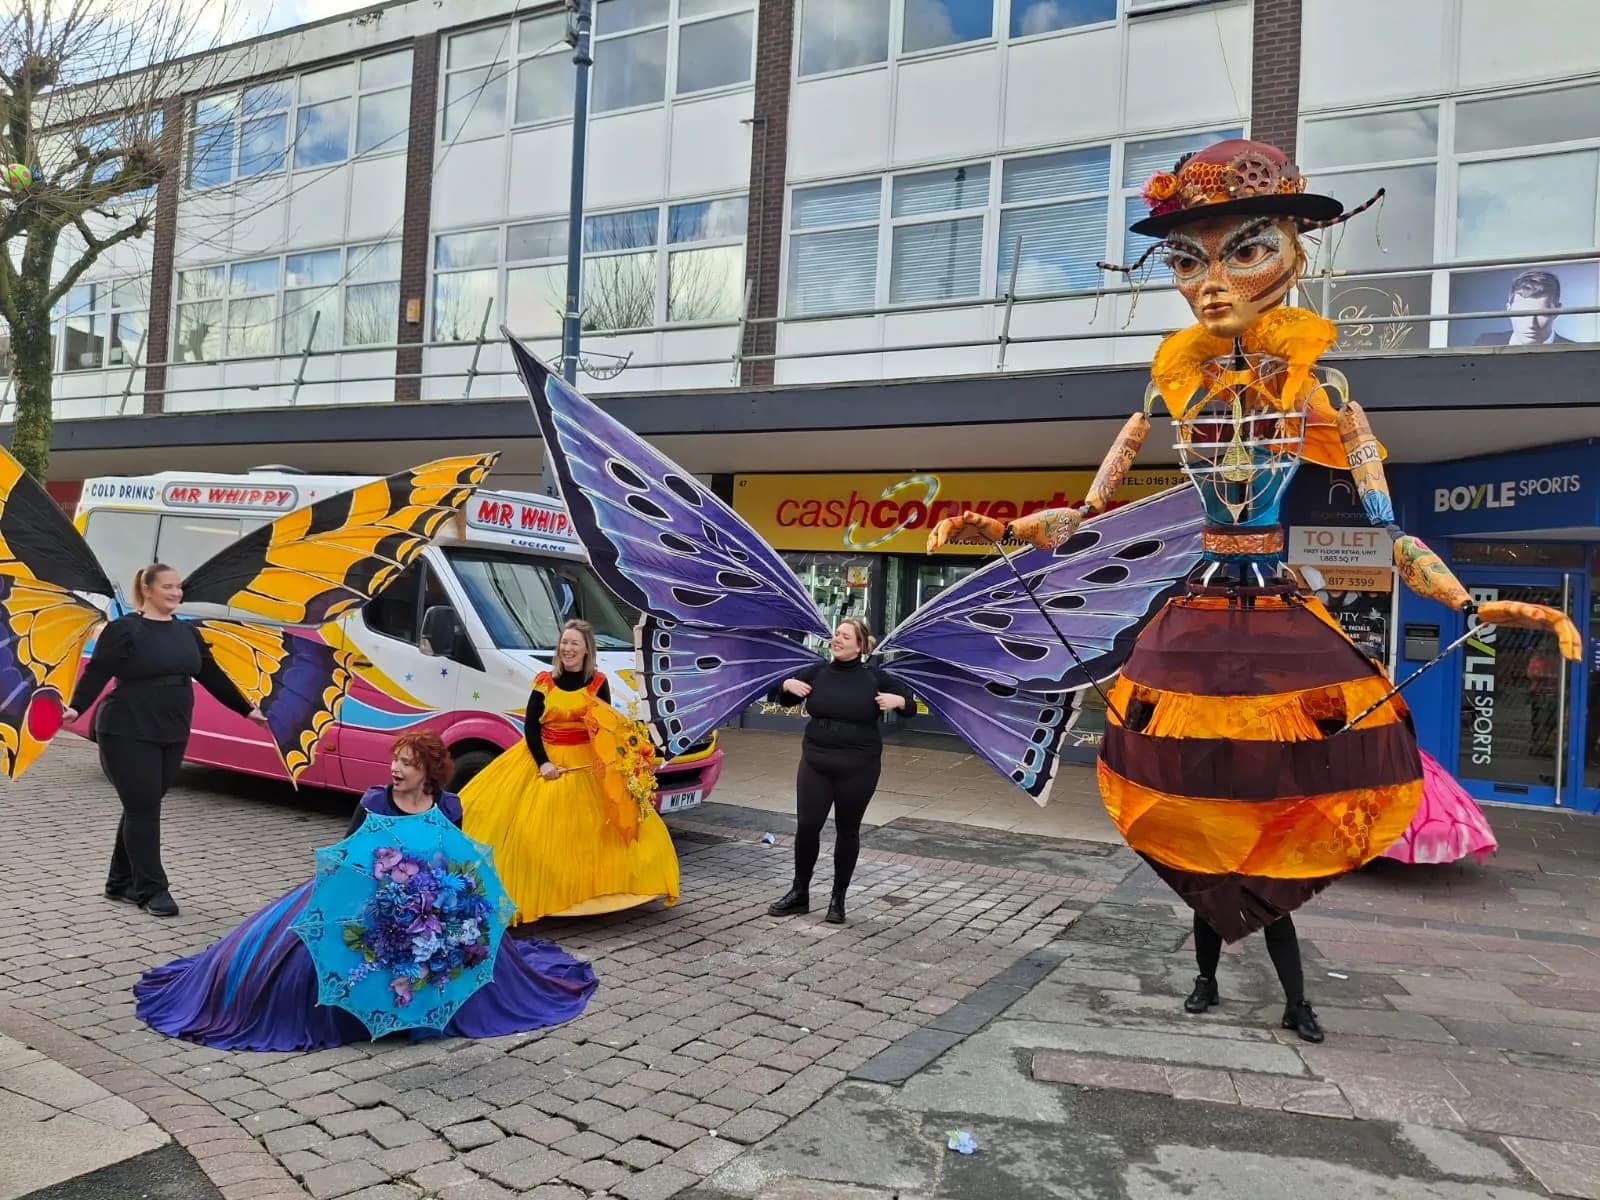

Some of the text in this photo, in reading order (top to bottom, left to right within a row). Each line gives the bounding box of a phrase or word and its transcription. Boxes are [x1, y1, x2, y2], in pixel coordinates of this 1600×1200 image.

[1122, 476, 1144, 486] TEL:
[1145, 476, 1169, 486] 0161
[91, 483, 155, 501] COLD DRINKS
[169, 487, 290, 506] MR WHIPPY
[1434, 475, 1581, 512] BOYLE SPORTS
[477, 499, 515, 528] MR
[511, 538, 566, 552] LUCIANO
[1304, 531, 1380, 548] TO LET
[1328, 577, 1344, 586] 817
[1472, 695, 1493, 765] SPORTS
